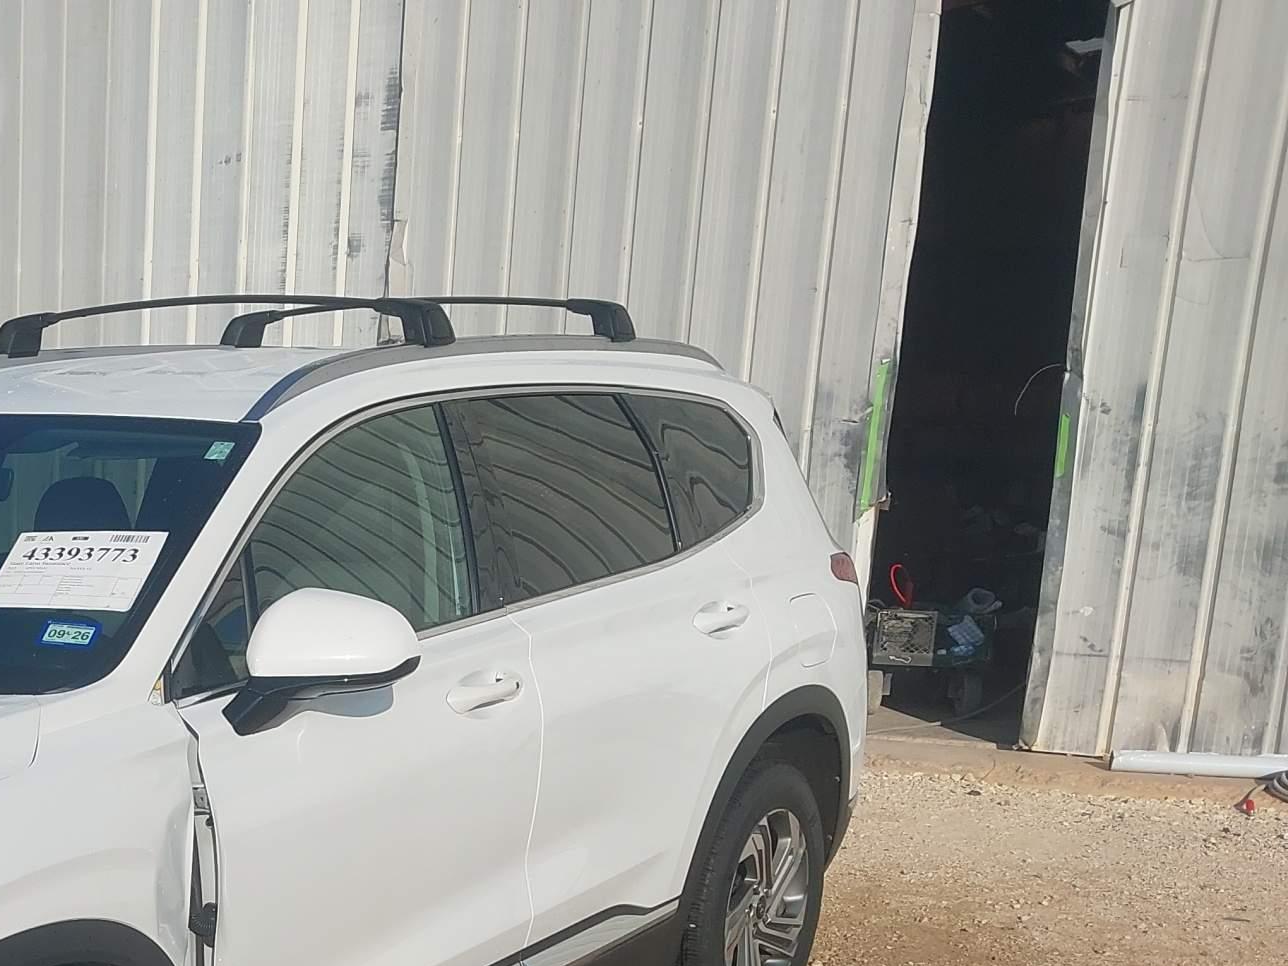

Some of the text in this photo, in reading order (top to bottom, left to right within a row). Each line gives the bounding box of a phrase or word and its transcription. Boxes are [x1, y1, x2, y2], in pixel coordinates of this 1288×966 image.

[22, 546, 139, 563] 43393773
[47, 629, 91, 641] 09 26
